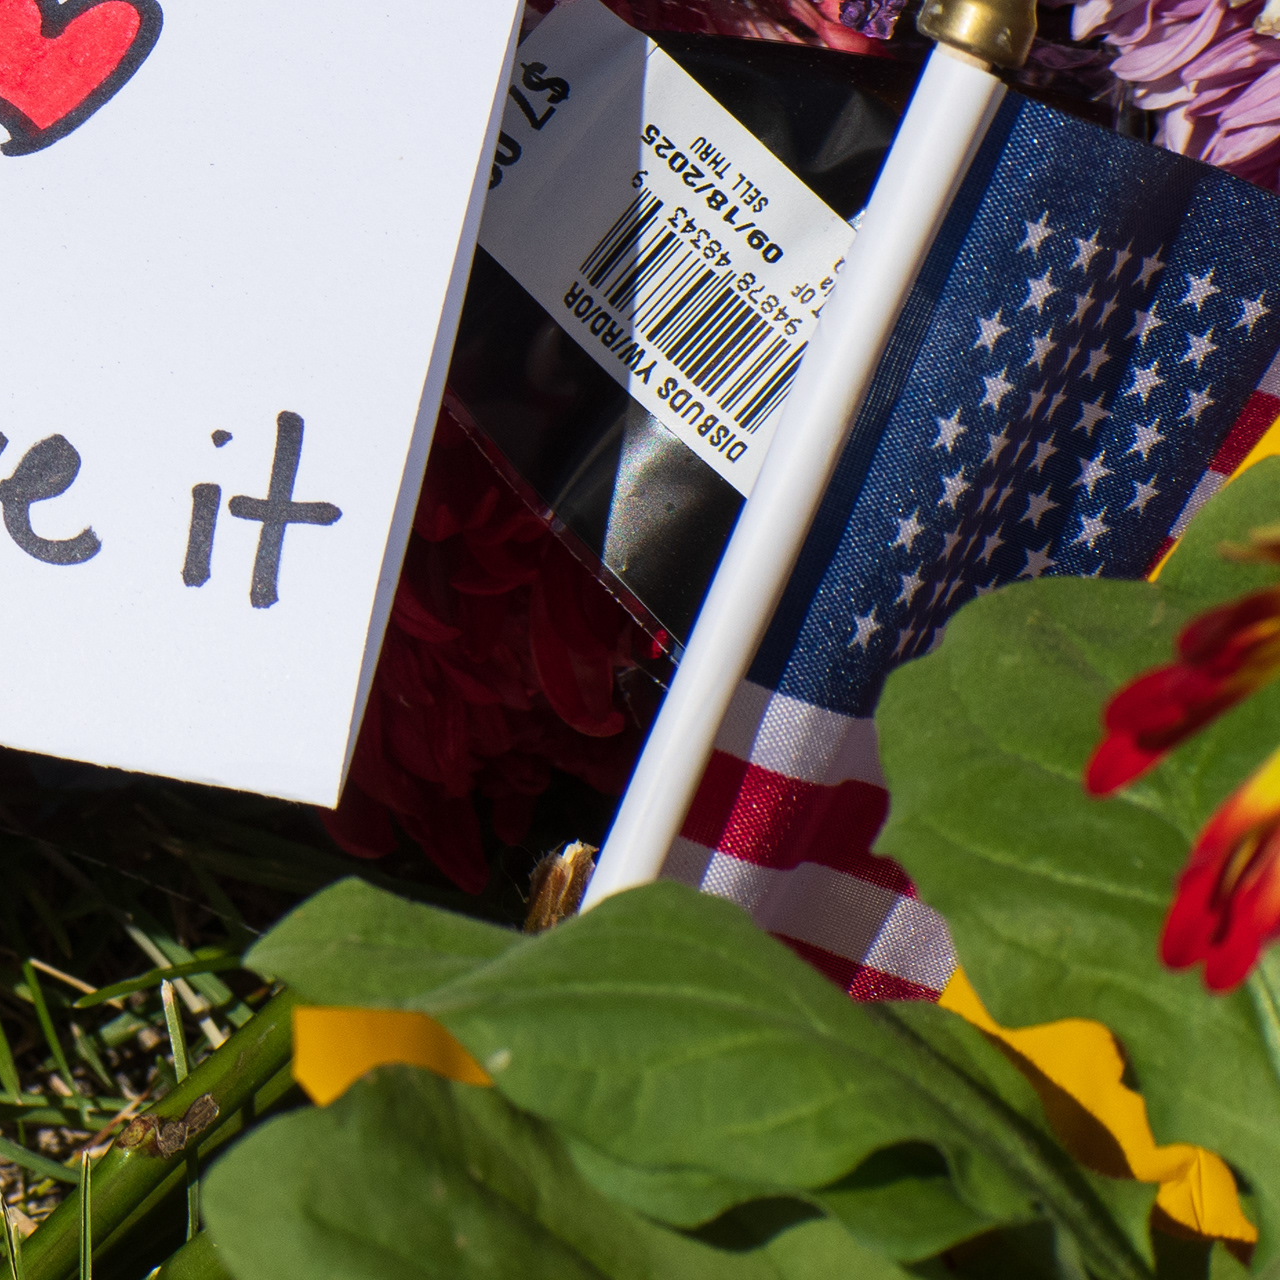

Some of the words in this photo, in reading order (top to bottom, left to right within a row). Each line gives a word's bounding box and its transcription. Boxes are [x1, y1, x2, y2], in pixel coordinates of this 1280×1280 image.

[641, 124, 783, 264] 09/18/2025
[689, 136, 733, 178] THRU
[731, 173, 769, 213] SELL
[564, 281, 656, 385] YW/RD/OR
[656, 377, 748, 464] DISBUDS
[183, 411, 342, 608] it
